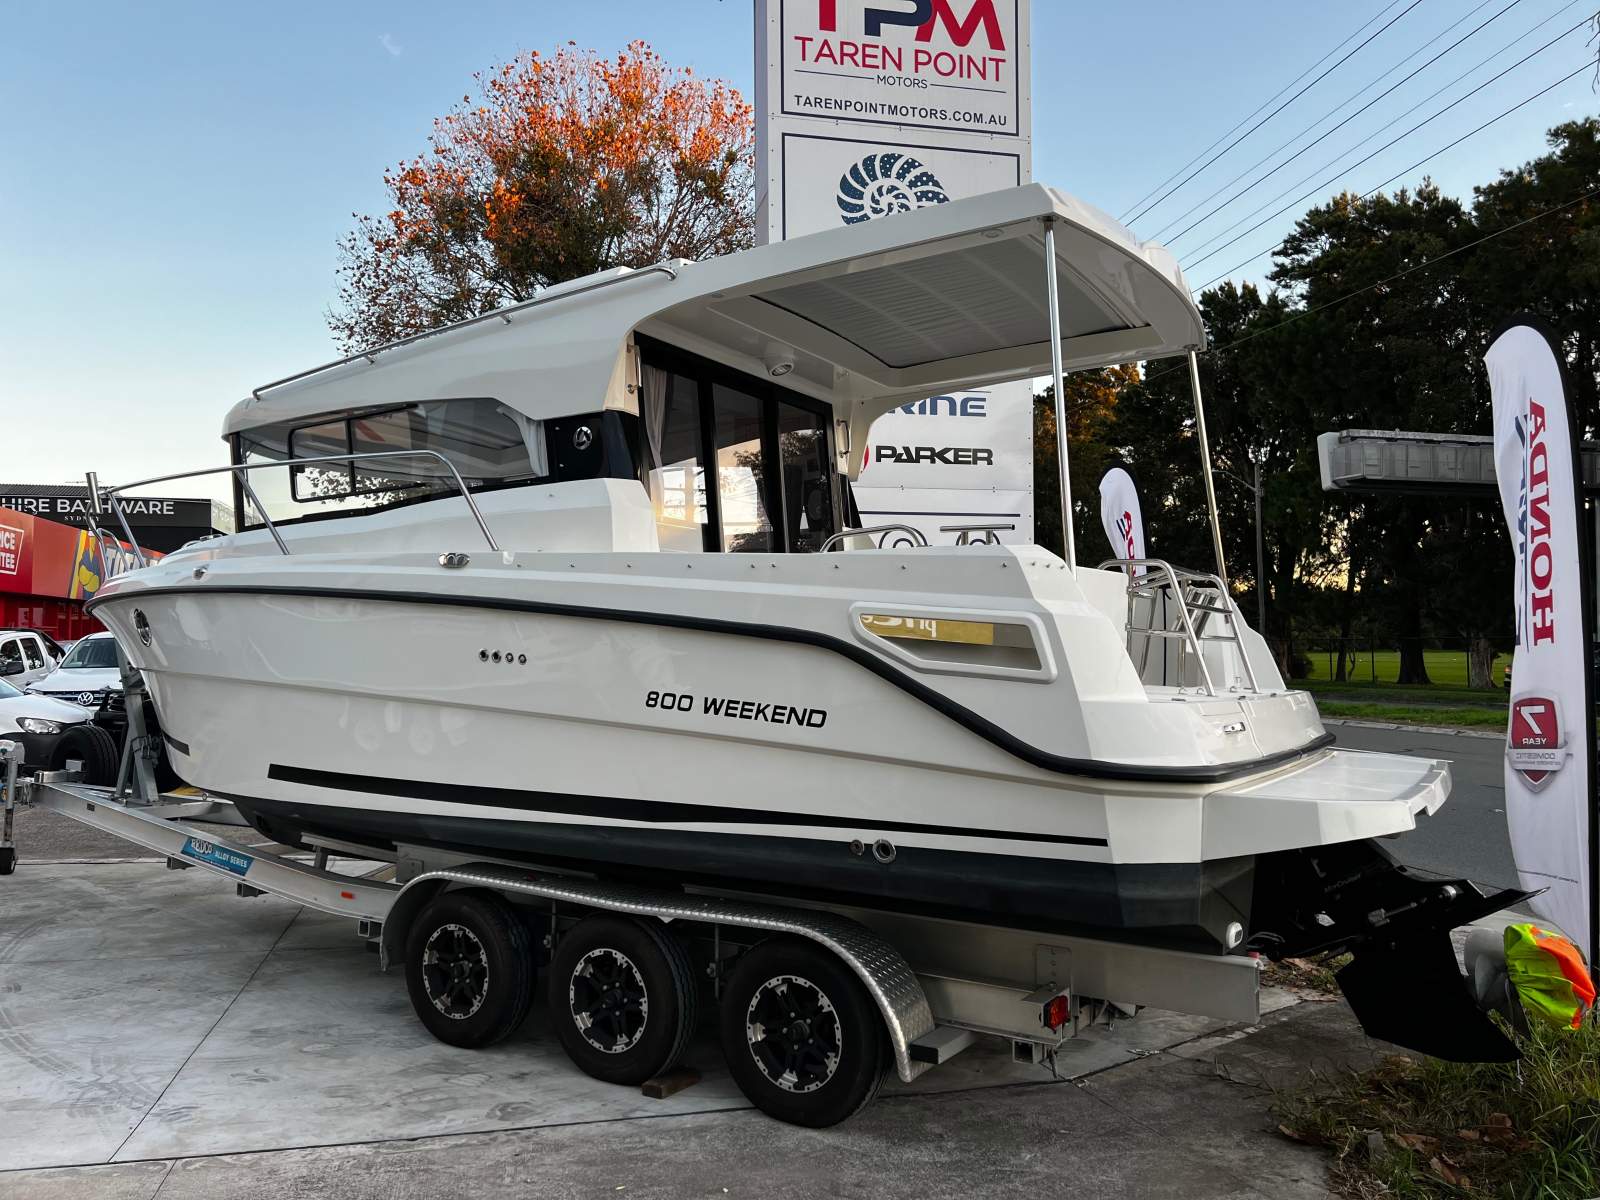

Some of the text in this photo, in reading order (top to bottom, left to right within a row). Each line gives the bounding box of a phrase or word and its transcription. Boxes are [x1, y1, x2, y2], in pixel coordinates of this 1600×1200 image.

[794, 36, 1006, 82] TAREN POINT
[877, 75, 928, 89] MOTORS
[795, 95, 1007, 126] TARENPOINTMOTORS.COM.AU
[875, 445, 993, 466] PARKER
[645, 691, 827, 728] 800 WEEKEND
[230, 856, 248, 868] SERIES
